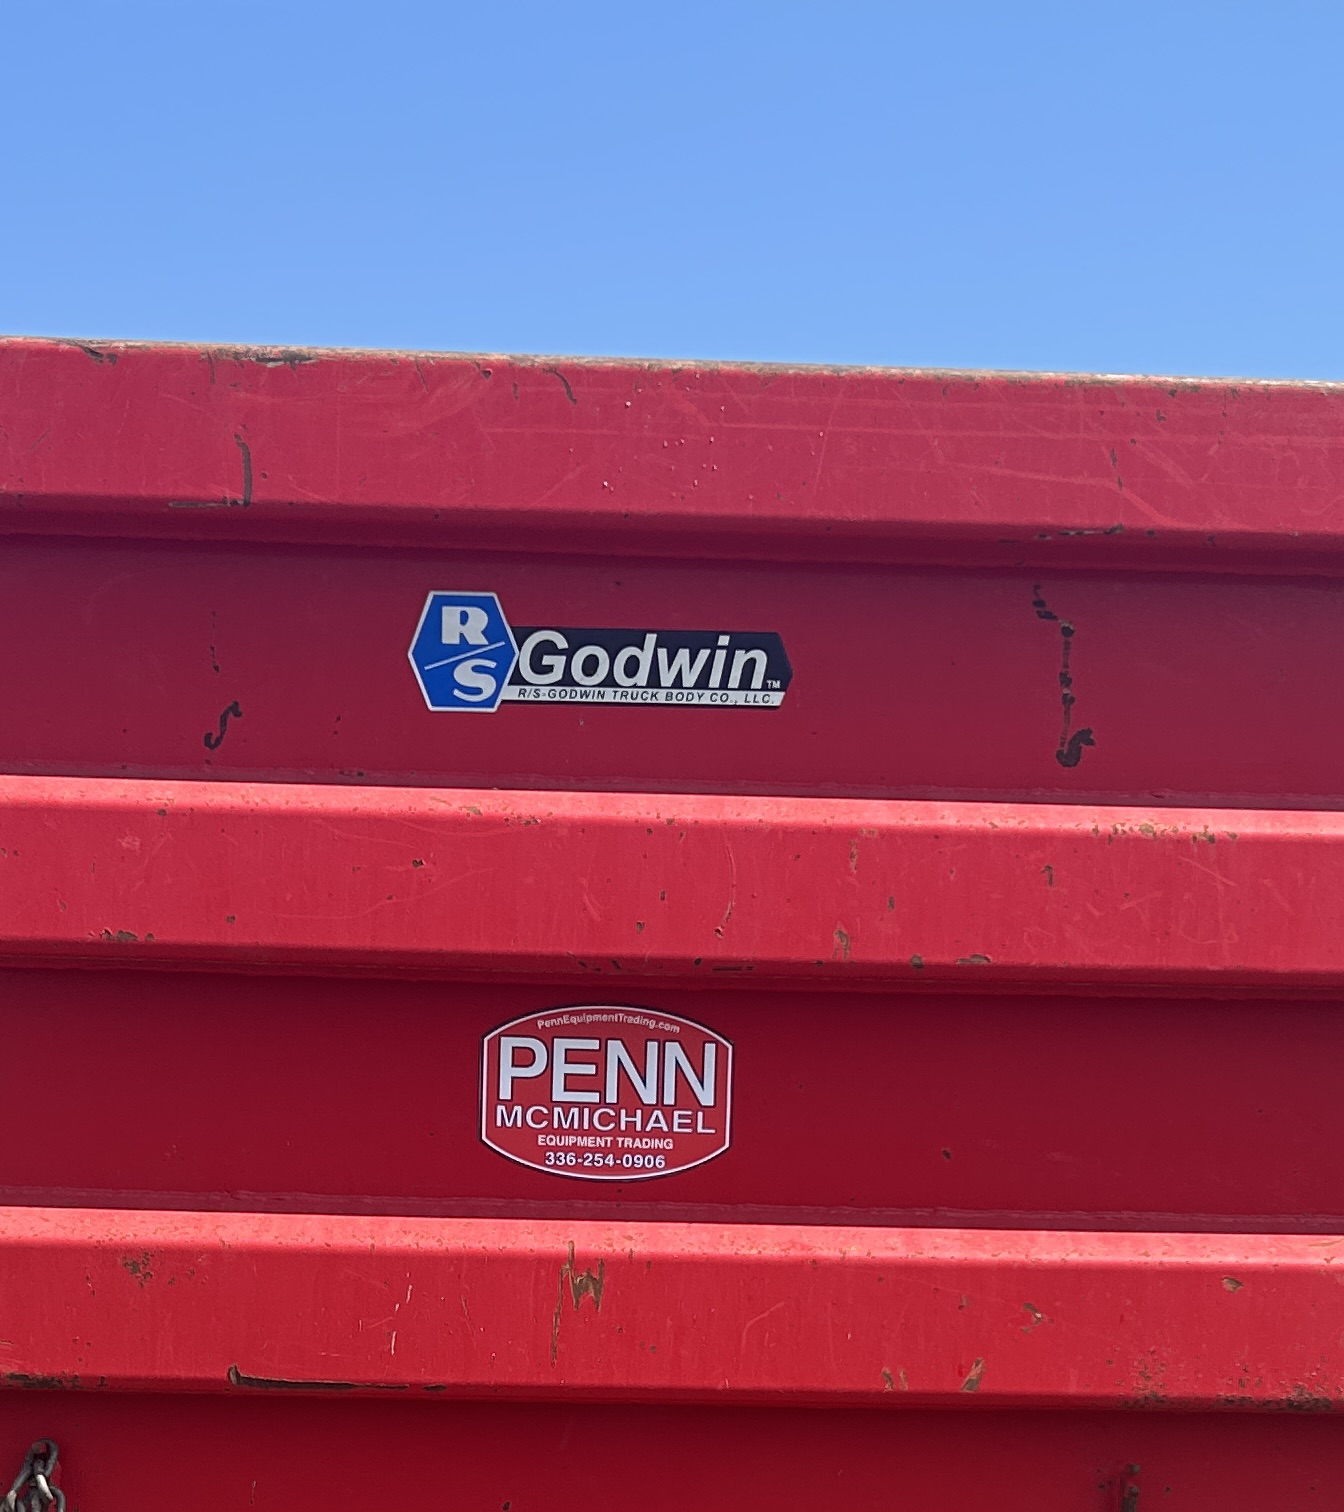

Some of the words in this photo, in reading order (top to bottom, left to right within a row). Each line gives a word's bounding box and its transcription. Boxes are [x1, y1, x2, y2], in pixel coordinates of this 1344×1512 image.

[518, 630, 768, 690] Godwin
[612, 690, 659, 701] TRUCK
[665, 691, 705, 702] BODY
[537, 1013, 680, 1034] PennEquipmentTrading.com
[499, 1036, 716, 1107] PENN
[496, 1105, 716, 1134] MCMICHAEL
[537, 1134, 613, 1148] EQUIPMENT
[616, 1137, 674, 1150] TRADING
[545, 1151, 666, 1169] 336-254-0906
